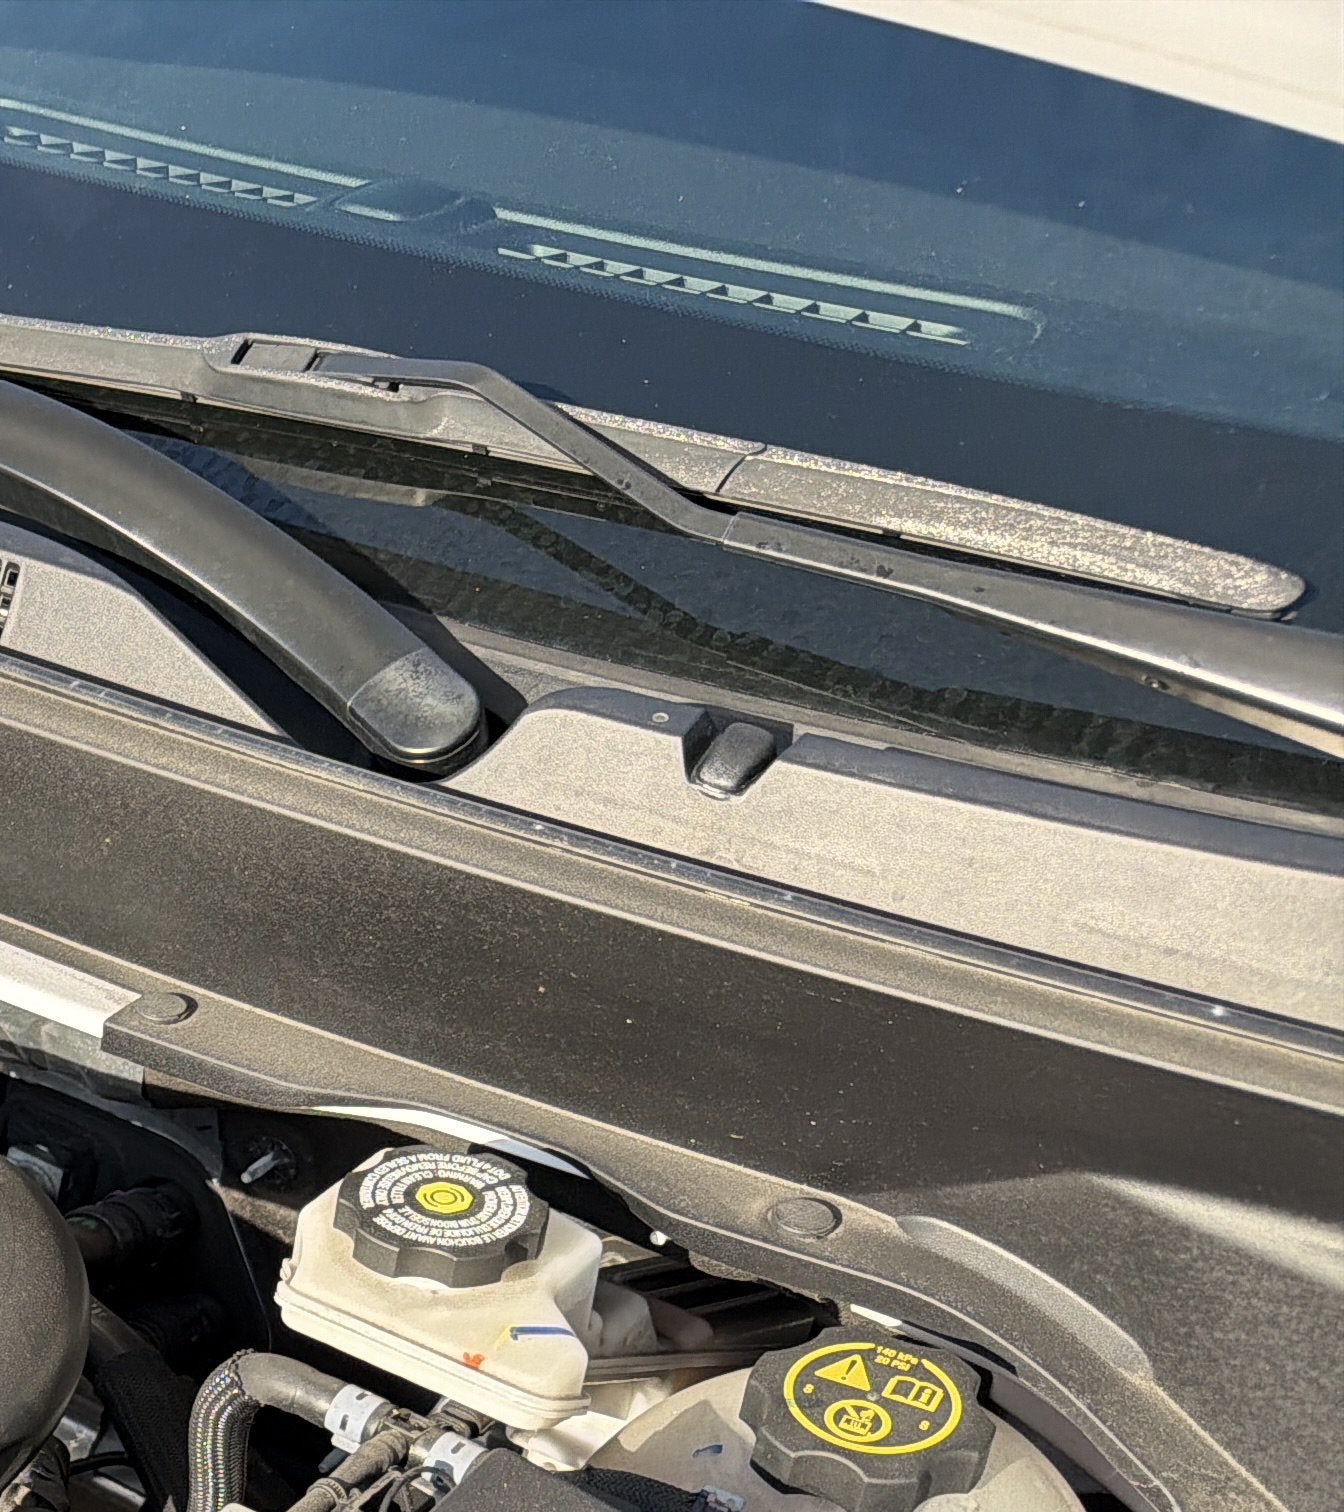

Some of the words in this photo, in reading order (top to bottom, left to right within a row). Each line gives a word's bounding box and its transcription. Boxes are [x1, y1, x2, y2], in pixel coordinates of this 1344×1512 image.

[416, 1152, 450, 1161] FROM
[451, 1153, 486, 1167] FLUID
[399, 1230, 437, 1245] AVANT
[435, 1235, 485, 1247] BOUCHON
[876, 1346, 897, 1359] 140
[898, 1352, 919, 1365] kPa
[874, 1356, 889, 1367] 20
[890, 1360, 911, 1372] PSI
